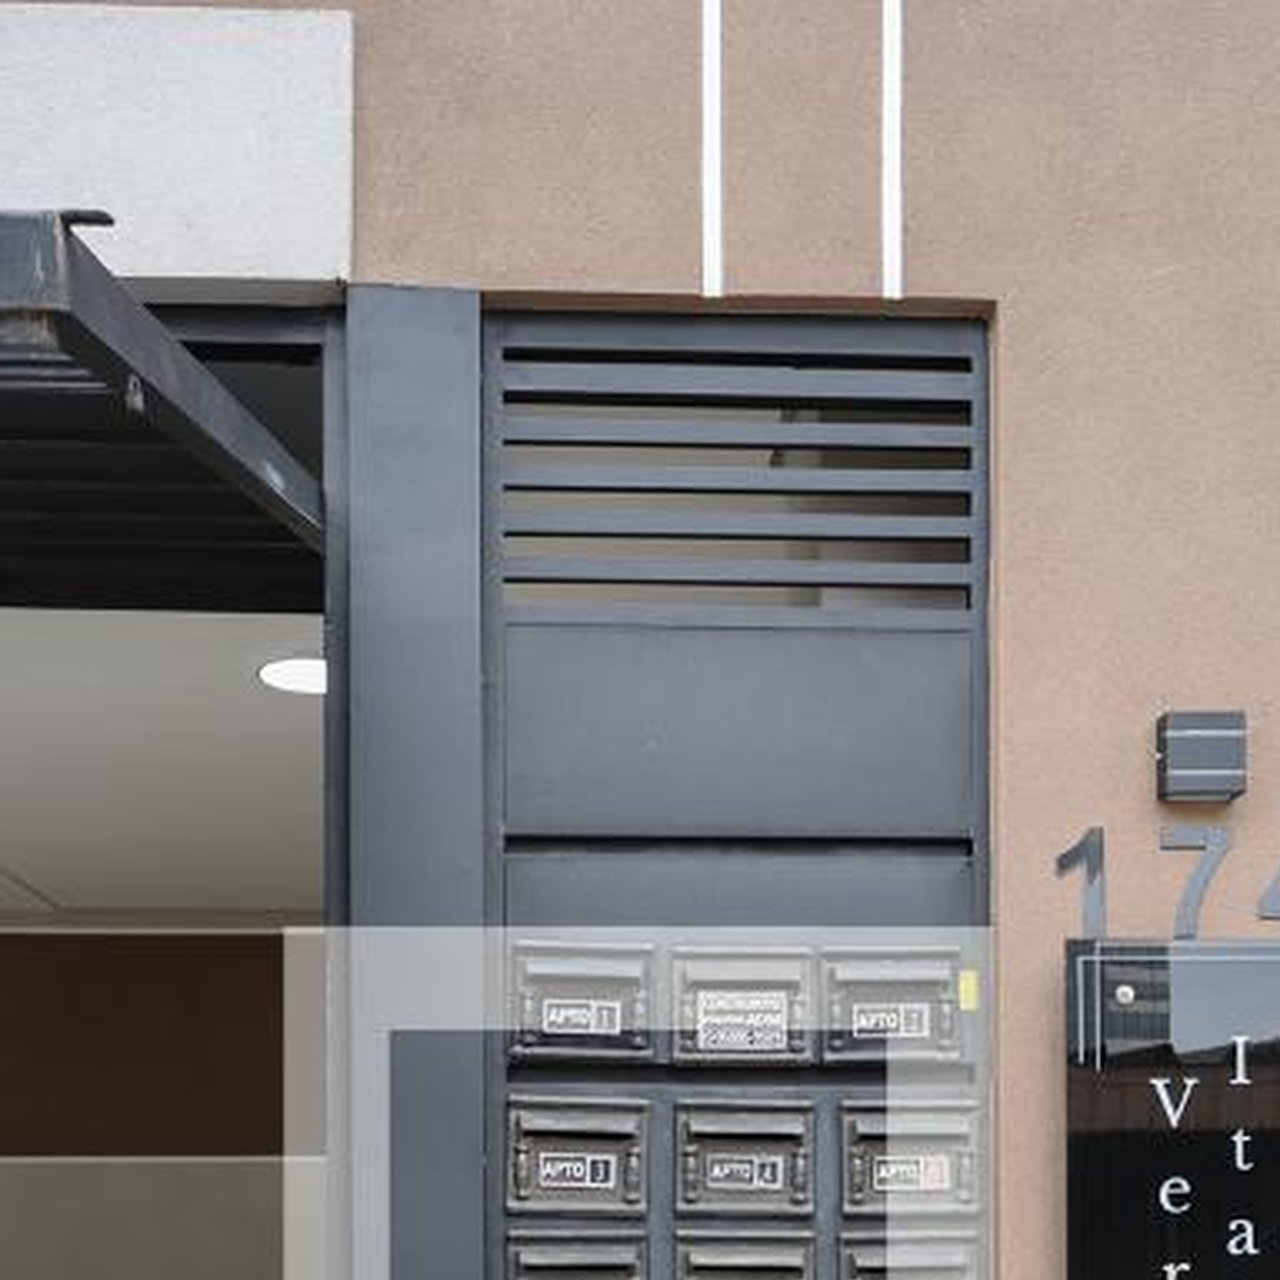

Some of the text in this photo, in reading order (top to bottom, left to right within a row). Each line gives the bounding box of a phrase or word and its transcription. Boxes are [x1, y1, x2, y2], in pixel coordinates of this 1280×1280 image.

[857, 1010, 898, 1028] APTO
[542, 1160, 585, 1178] APTO
[711, 1162, 752, 1179] APTO
[877, 1163, 918, 1180] APTO
